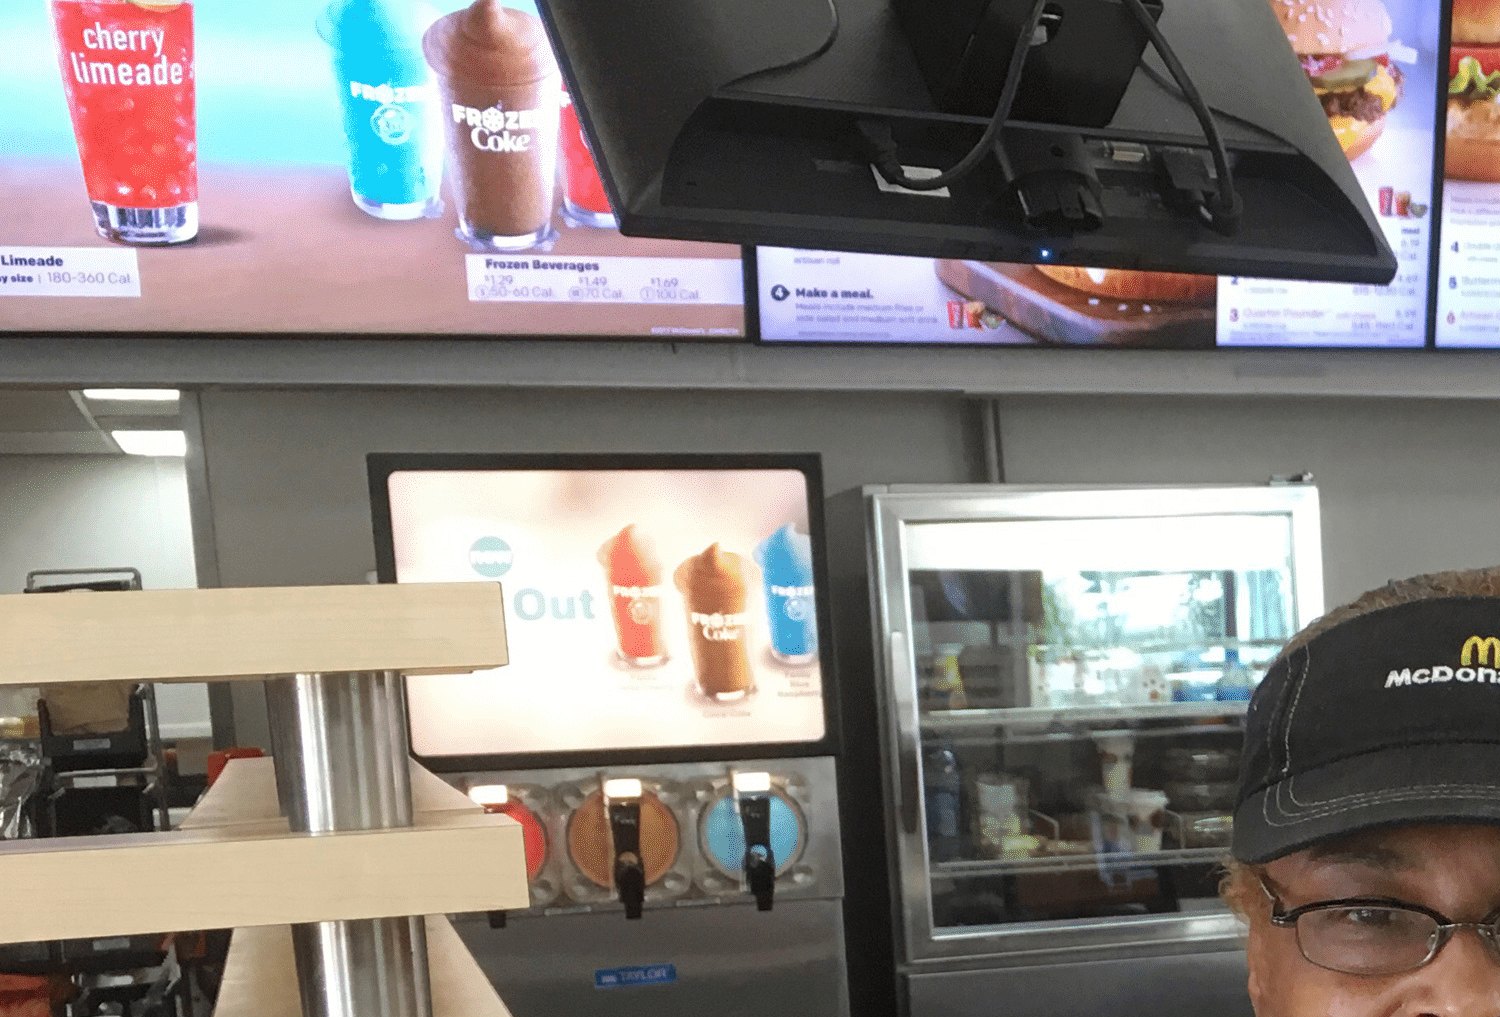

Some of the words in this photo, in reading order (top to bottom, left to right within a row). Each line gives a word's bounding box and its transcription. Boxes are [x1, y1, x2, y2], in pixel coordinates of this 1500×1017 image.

[83, 21, 164, 57] cherry
[70, 51, 183, 85] limeade
[470, 126, 531, 153] Coke
[1, 254, 64, 267] Limeade
[485, 259, 529, 270] Frozen
[532, 259, 599, 272] Beverages
[10, 273, 34, 284] size
[47, 271, 105, 284] 180-360
[108, 271, 131, 284] Cal
[795, 288, 828, 298] Make
[831, 290, 839, 298] a
[841, 288, 874, 299] meal.
[513, 588, 596, 621] Out
